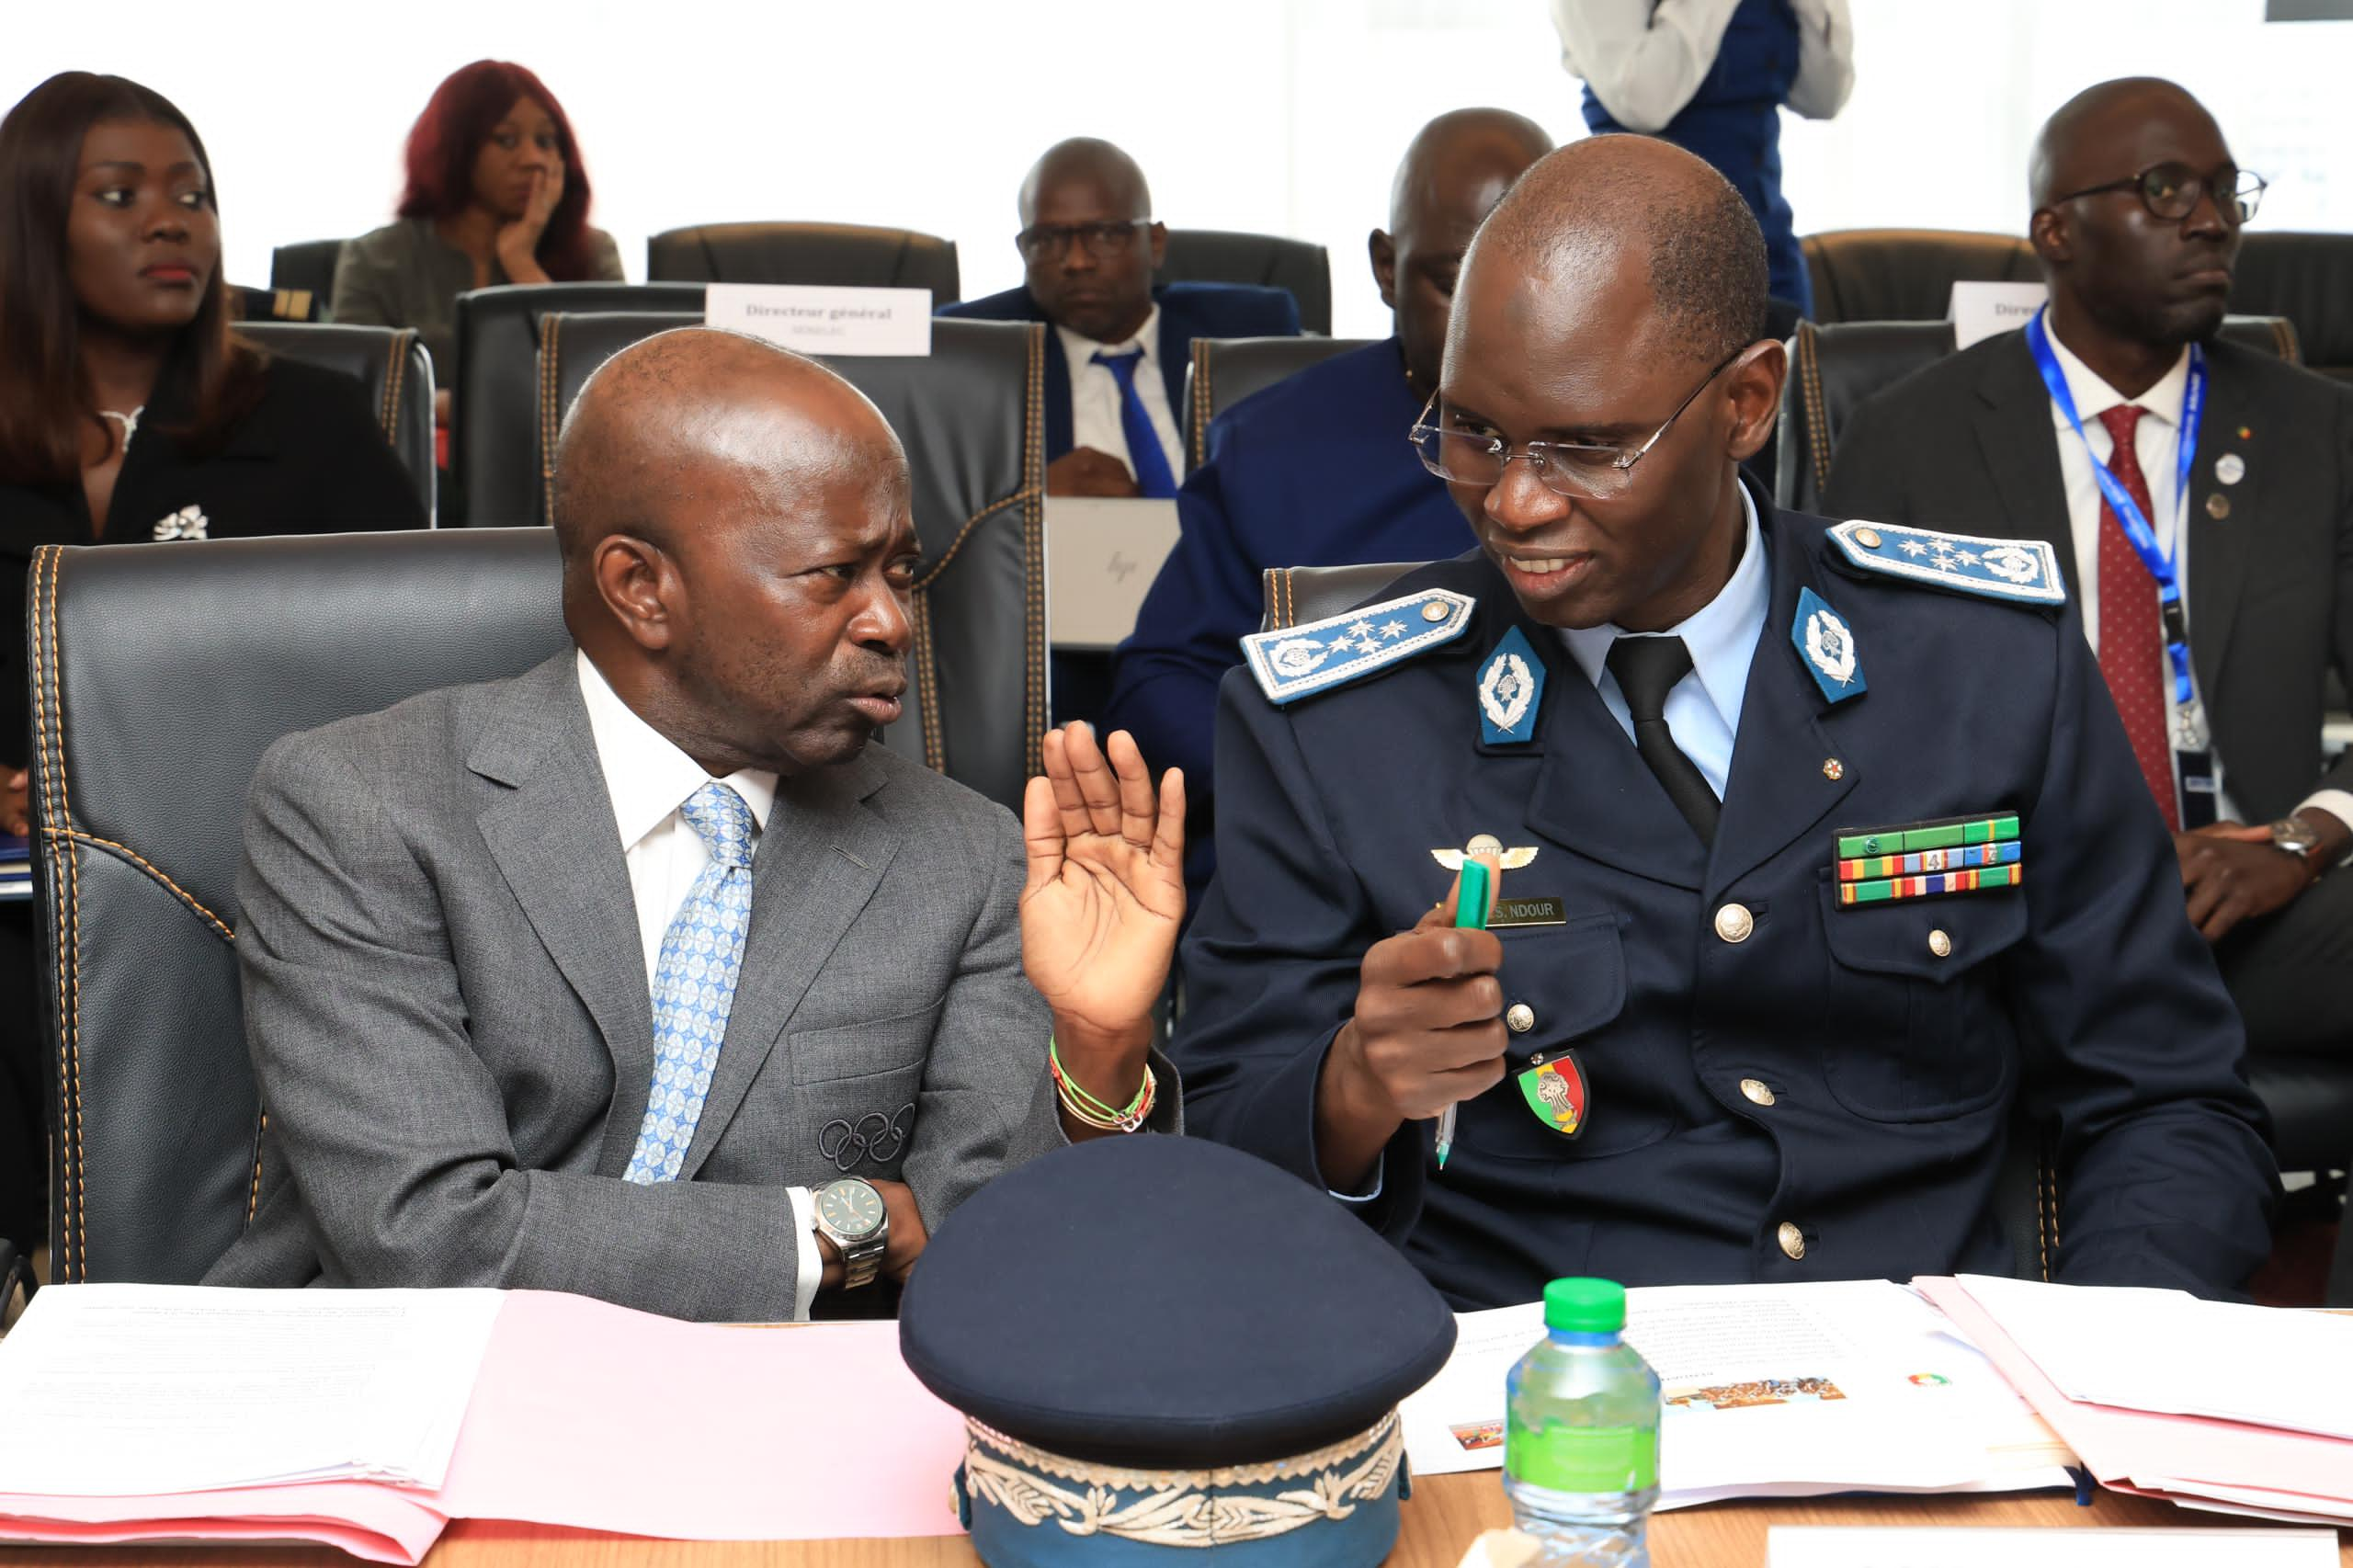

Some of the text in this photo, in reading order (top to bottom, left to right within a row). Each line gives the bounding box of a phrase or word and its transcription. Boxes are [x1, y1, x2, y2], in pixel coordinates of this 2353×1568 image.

[745, 303, 892, 321] Directeur général
[1495, 903, 1554, 919] S. NDOUR
